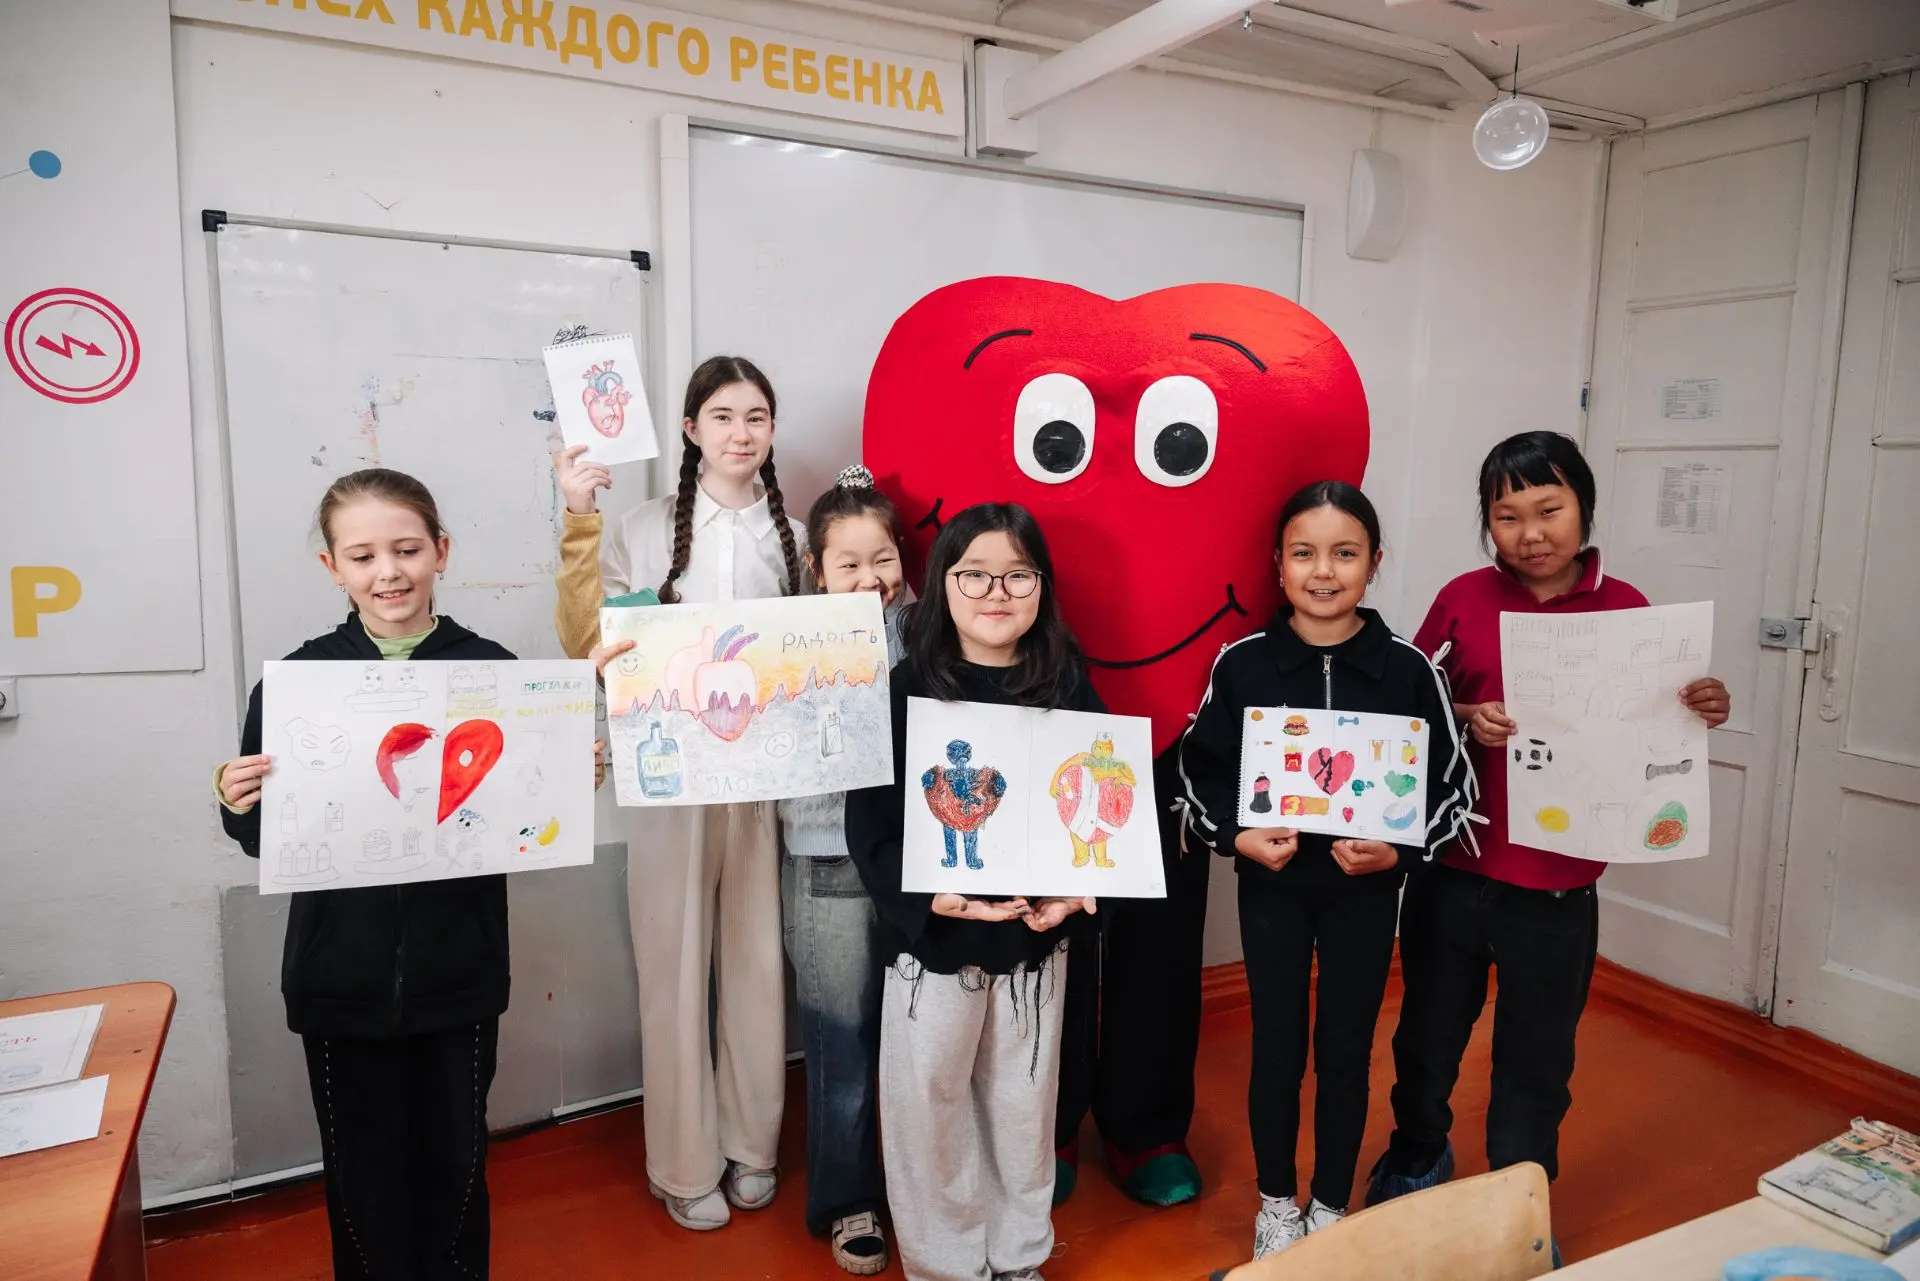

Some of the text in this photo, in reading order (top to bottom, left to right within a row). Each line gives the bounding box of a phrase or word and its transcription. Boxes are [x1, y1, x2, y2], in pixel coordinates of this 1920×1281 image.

[416, 0, 944, 116] КАЖДОГО РЕБЕНКА
[782, 628, 878, 653] РАДОСТЬ
